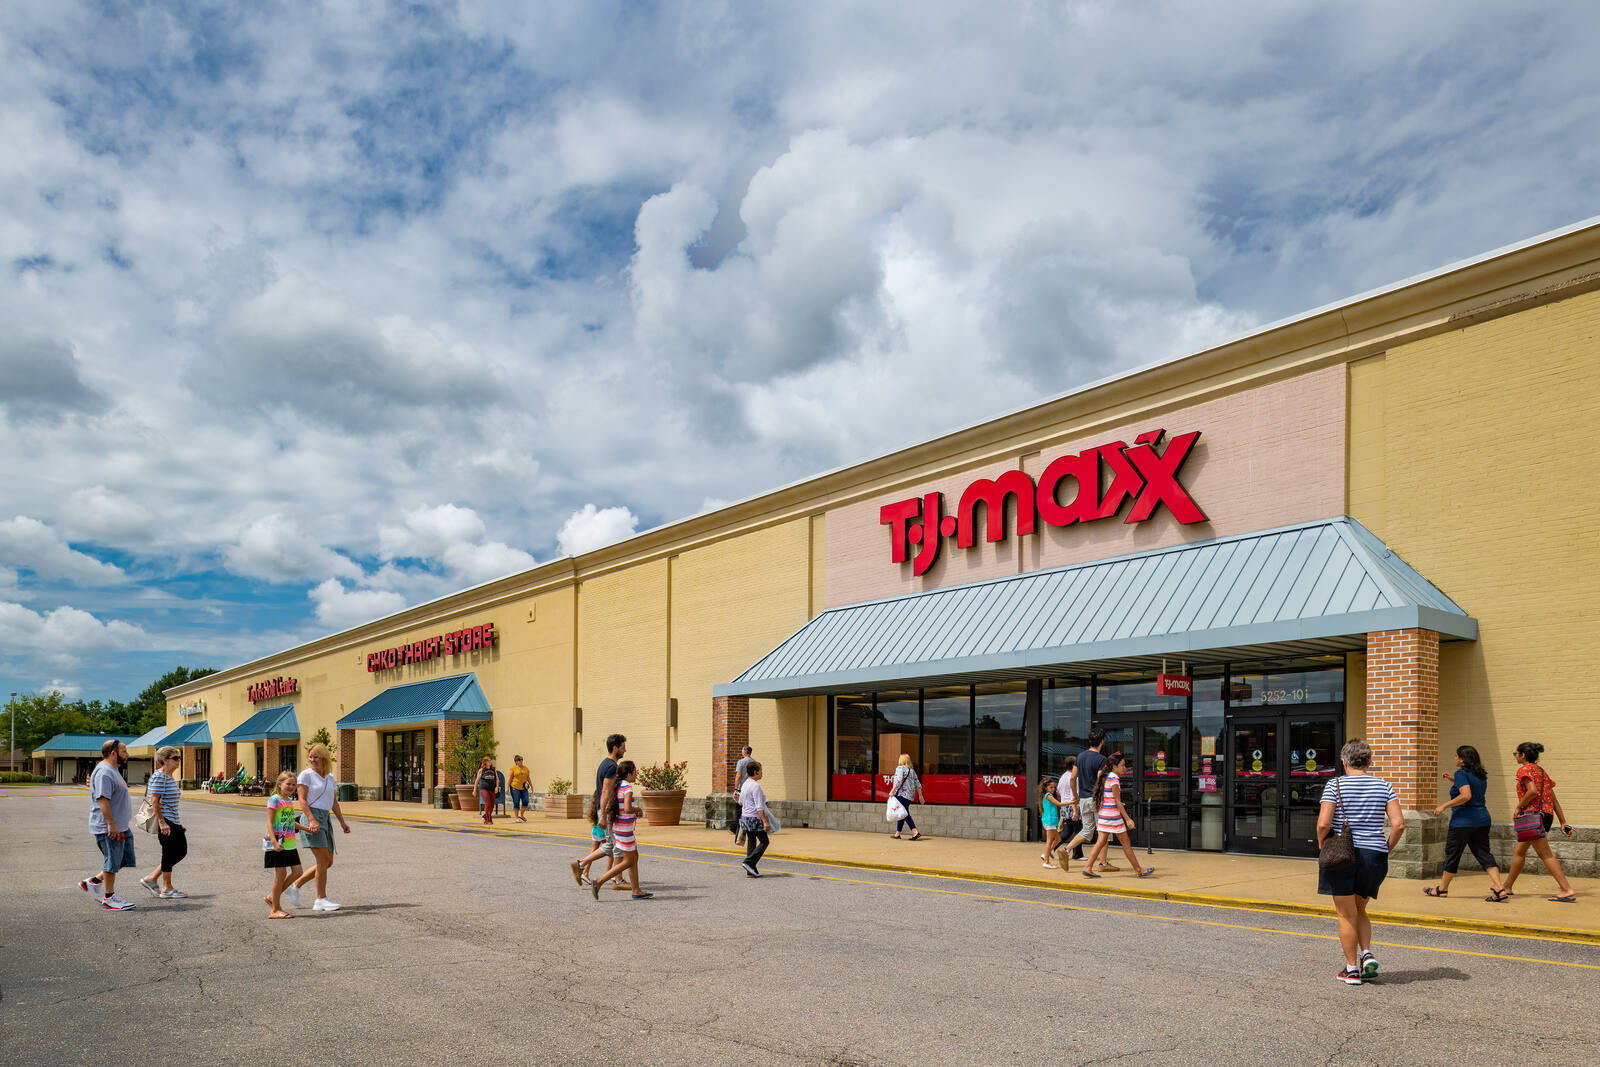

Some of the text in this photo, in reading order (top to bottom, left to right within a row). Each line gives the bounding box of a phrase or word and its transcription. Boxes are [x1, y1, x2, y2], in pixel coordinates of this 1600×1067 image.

[367, 622, 494, 673] CHKD THRIFT STORE
